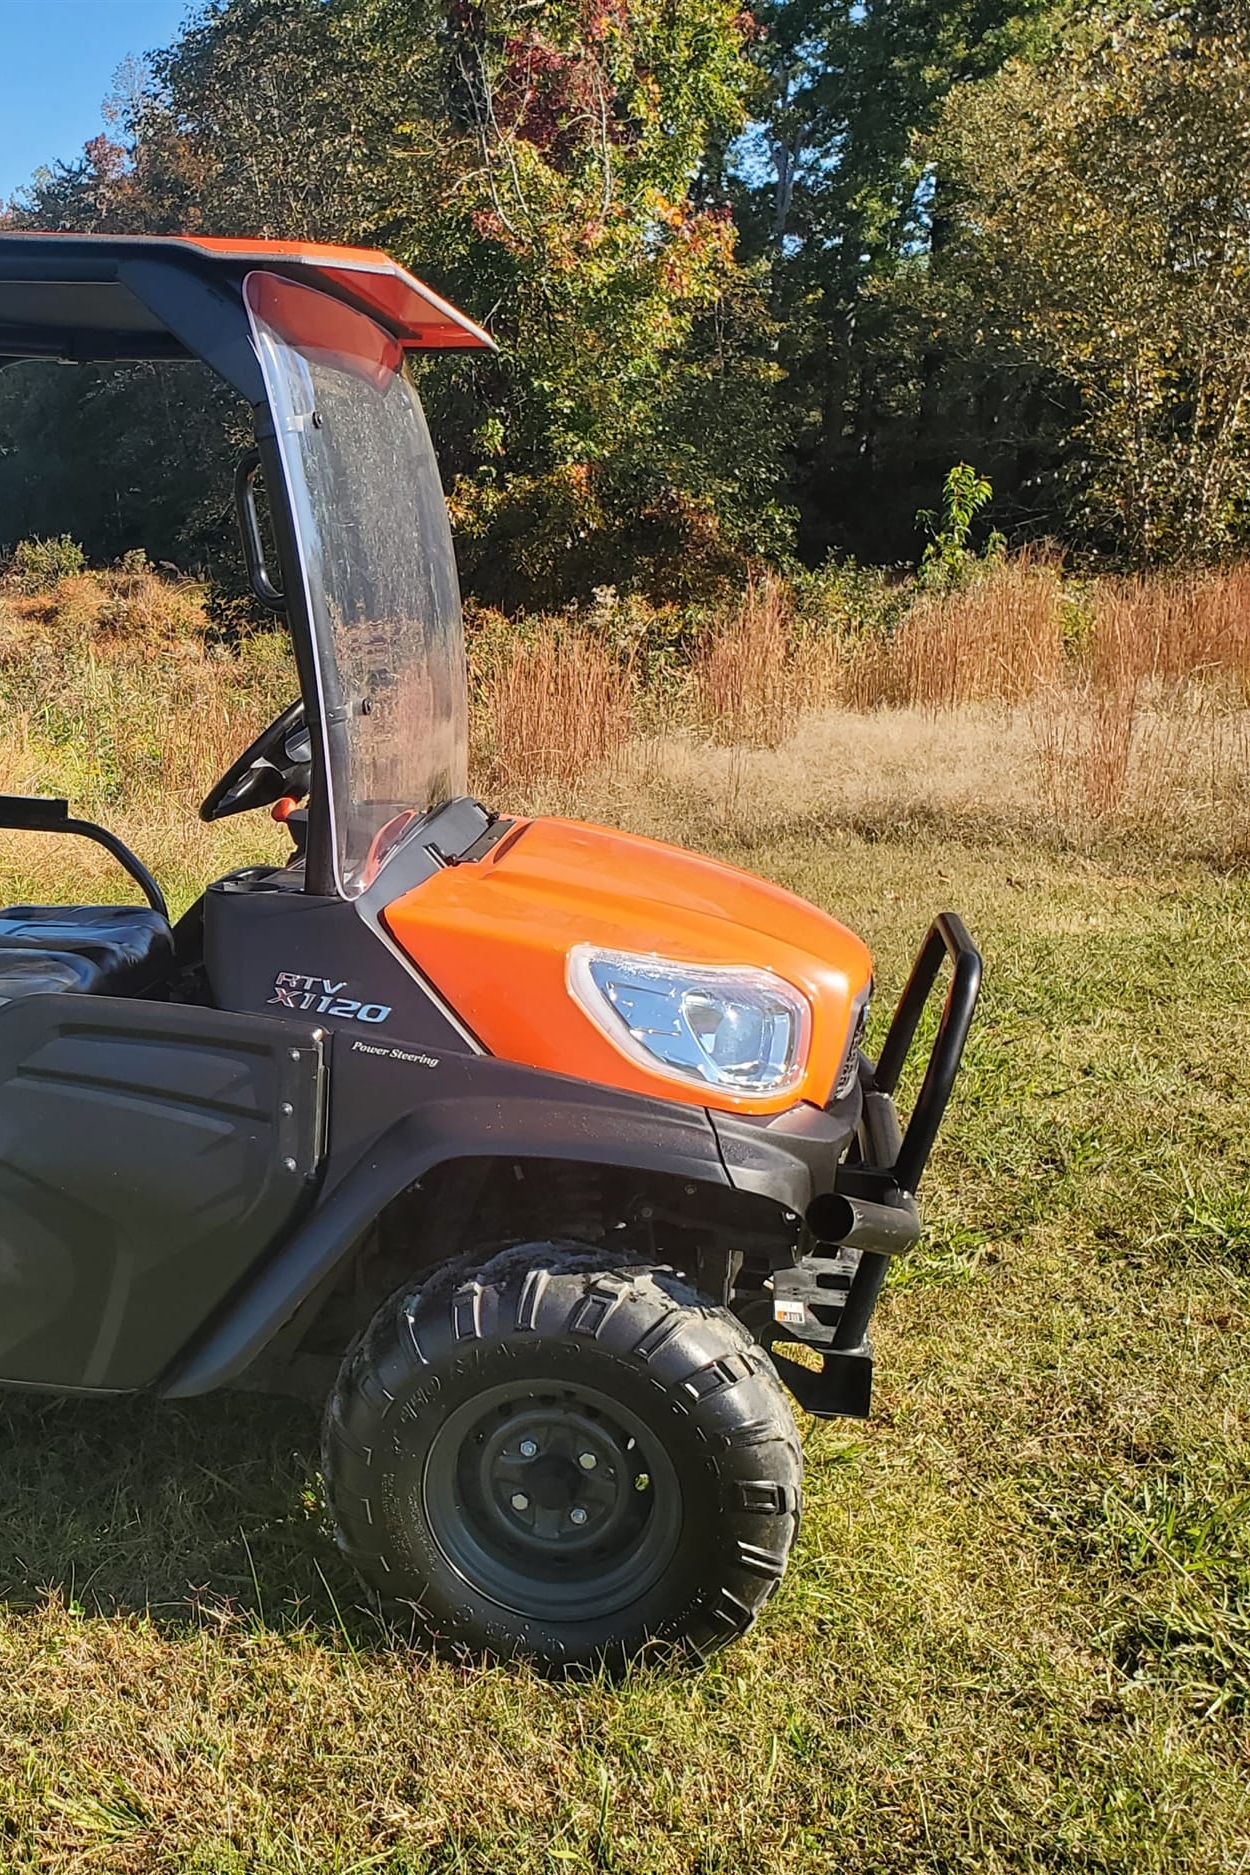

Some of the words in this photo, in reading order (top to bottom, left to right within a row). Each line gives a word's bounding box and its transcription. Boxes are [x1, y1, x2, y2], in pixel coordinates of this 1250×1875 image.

[275, 971, 348, 994] RTV
[267, 986, 393, 1023] X1120
[351, 1041, 390, 1056] Power
[389, 1048, 440, 1068] Steering
